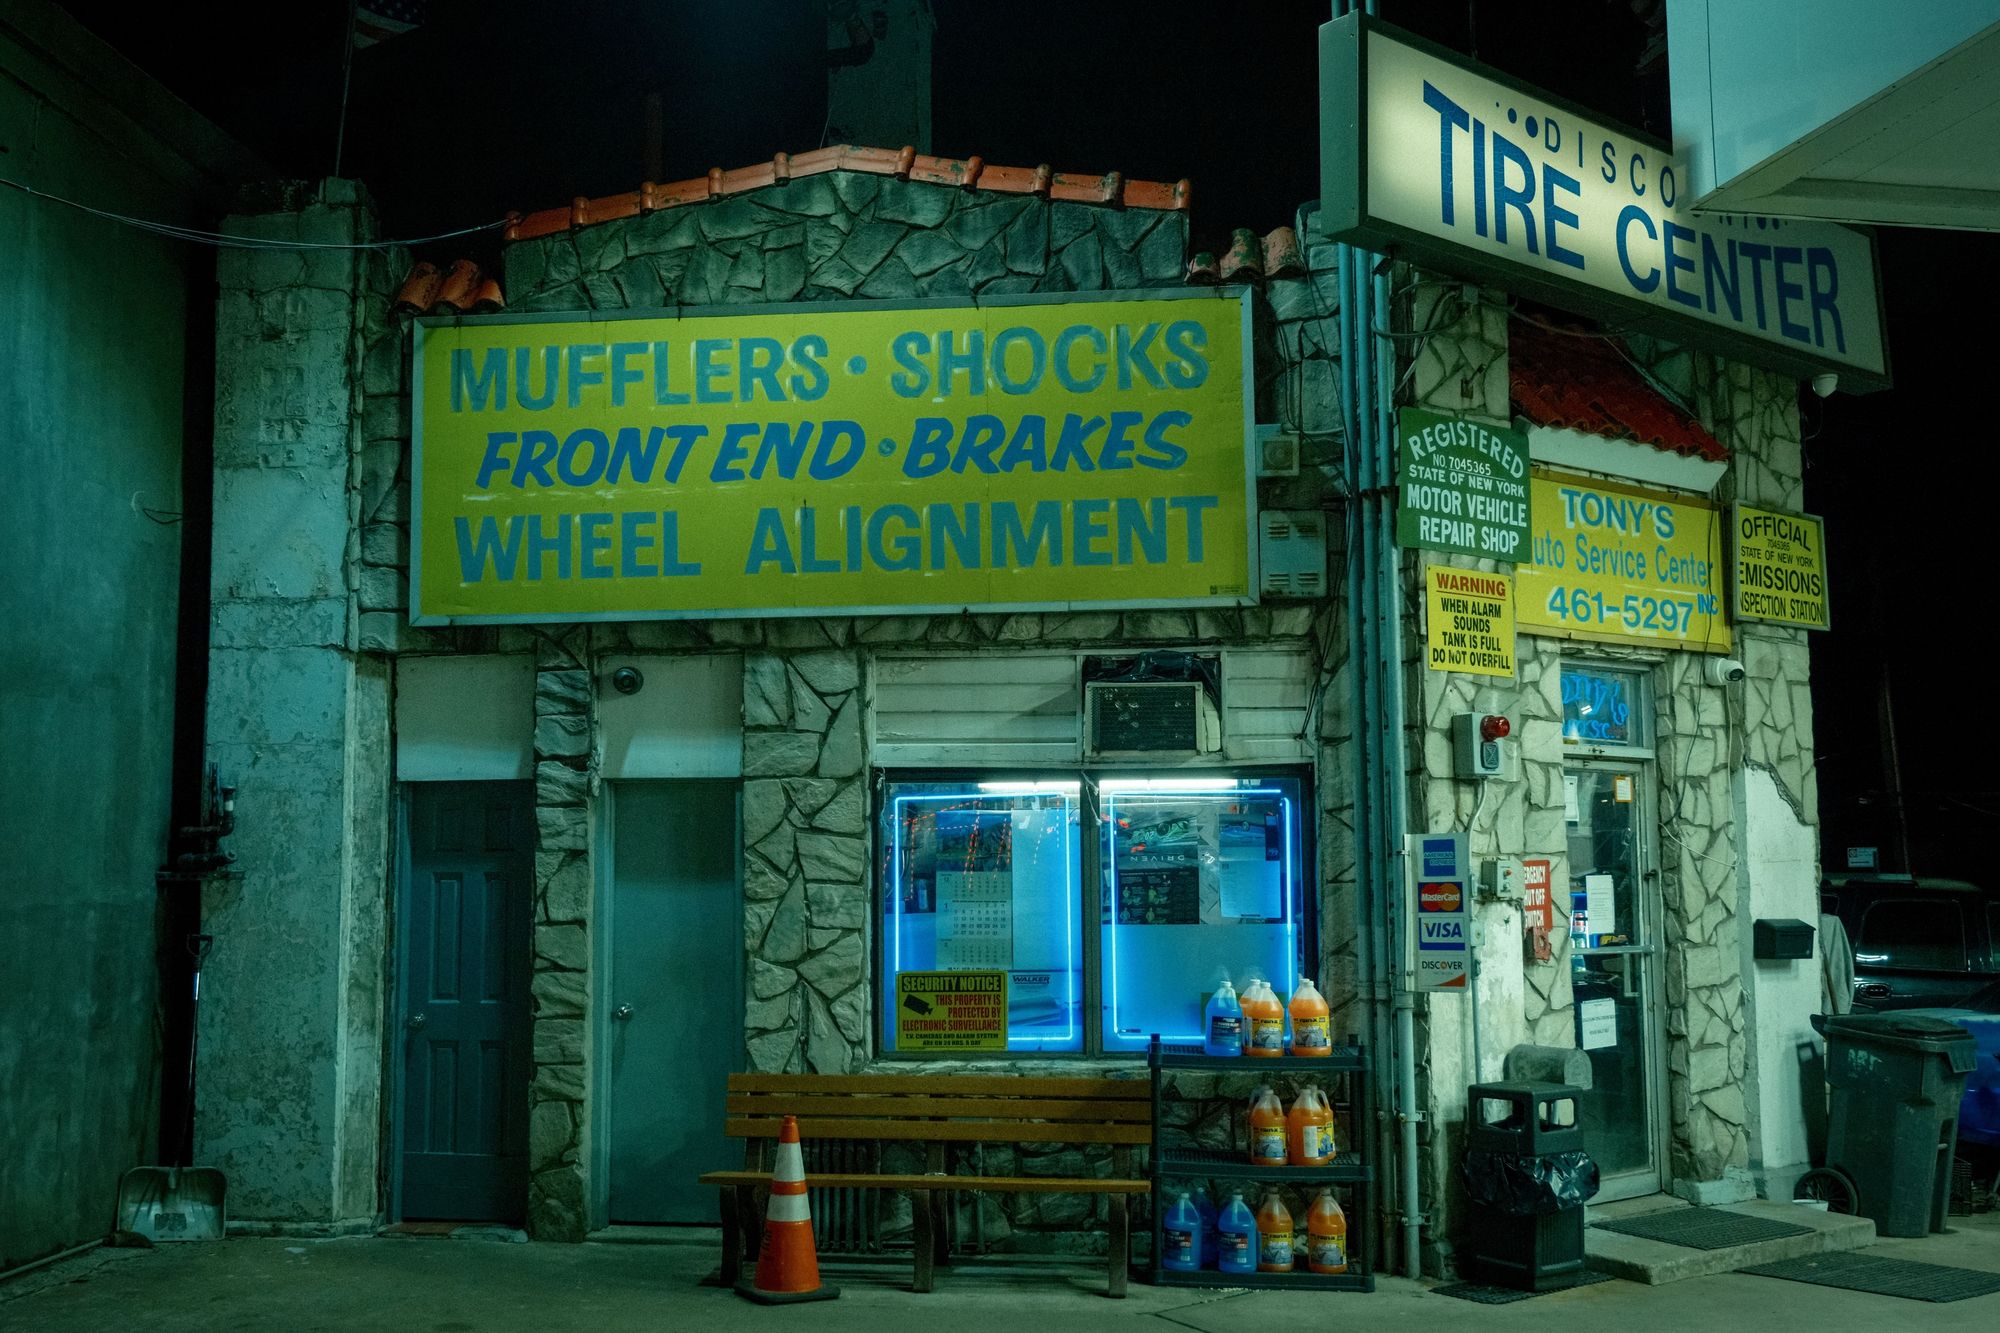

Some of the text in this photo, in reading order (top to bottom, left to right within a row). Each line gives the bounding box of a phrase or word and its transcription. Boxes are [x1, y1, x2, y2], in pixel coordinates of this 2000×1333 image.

[1422, 79, 1847, 355] TIRE CENTER
[450, 320, 1210, 413] MUFFLERS SHOCKS
[475, 410, 1192, 490] FRONT END BRAKES
[1408, 421, 1524, 479] REGISTERED
[1448, 456, 1491, 476] 7045365
[1408, 464, 1525, 498] STATE OF NEW YORK
[1407, 483, 1527, 528] MOTOR VEHICLE
[1558, 488, 1676, 540] TONY'S
[453, 495, 1218, 583] WHEEL ALIGNMENT
[1419, 516, 1520, 554] REPAIR SHOP
[1742, 516, 1811, 552] OFFICIAL
[1534, 531, 1714, 588] uto Service Center
[1741, 546, 1814, 568] STATE OF NEW YORK
[1436, 572, 1506, 597] WARNING
[1441, 598, 1502, 618] WHEN ALARM
[1548, 586, 1694, 635] 461-5297
[1697, 594, 1720, 616] INC
[1790, 599, 1824, 622] STATION
[1454, 616, 1490, 634] SOUNDS
[1442, 632, 1502, 652] TANK IS FULL
[1433, 648, 1511, 670] DO NOT OVERFILL
[1421, 893, 1460, 902] MasterCard
[1536, 888, 1545, 905] OFF
[1424, 922, 1462, 938] VISA
[1422, 961, 1462, 970] DISCOVER
[903, 976, 1000, 992] SECURITY NOTICE
[1012, 975, 1050, 984] WALKER
[936, 994, 1001, 1005] THIS PROPERTY IS
[948, 1007, 1001, 1018] PROTECTED BY
[902, 1020, 1001, 1031] ELECTRONIC SURVEILLANCE
